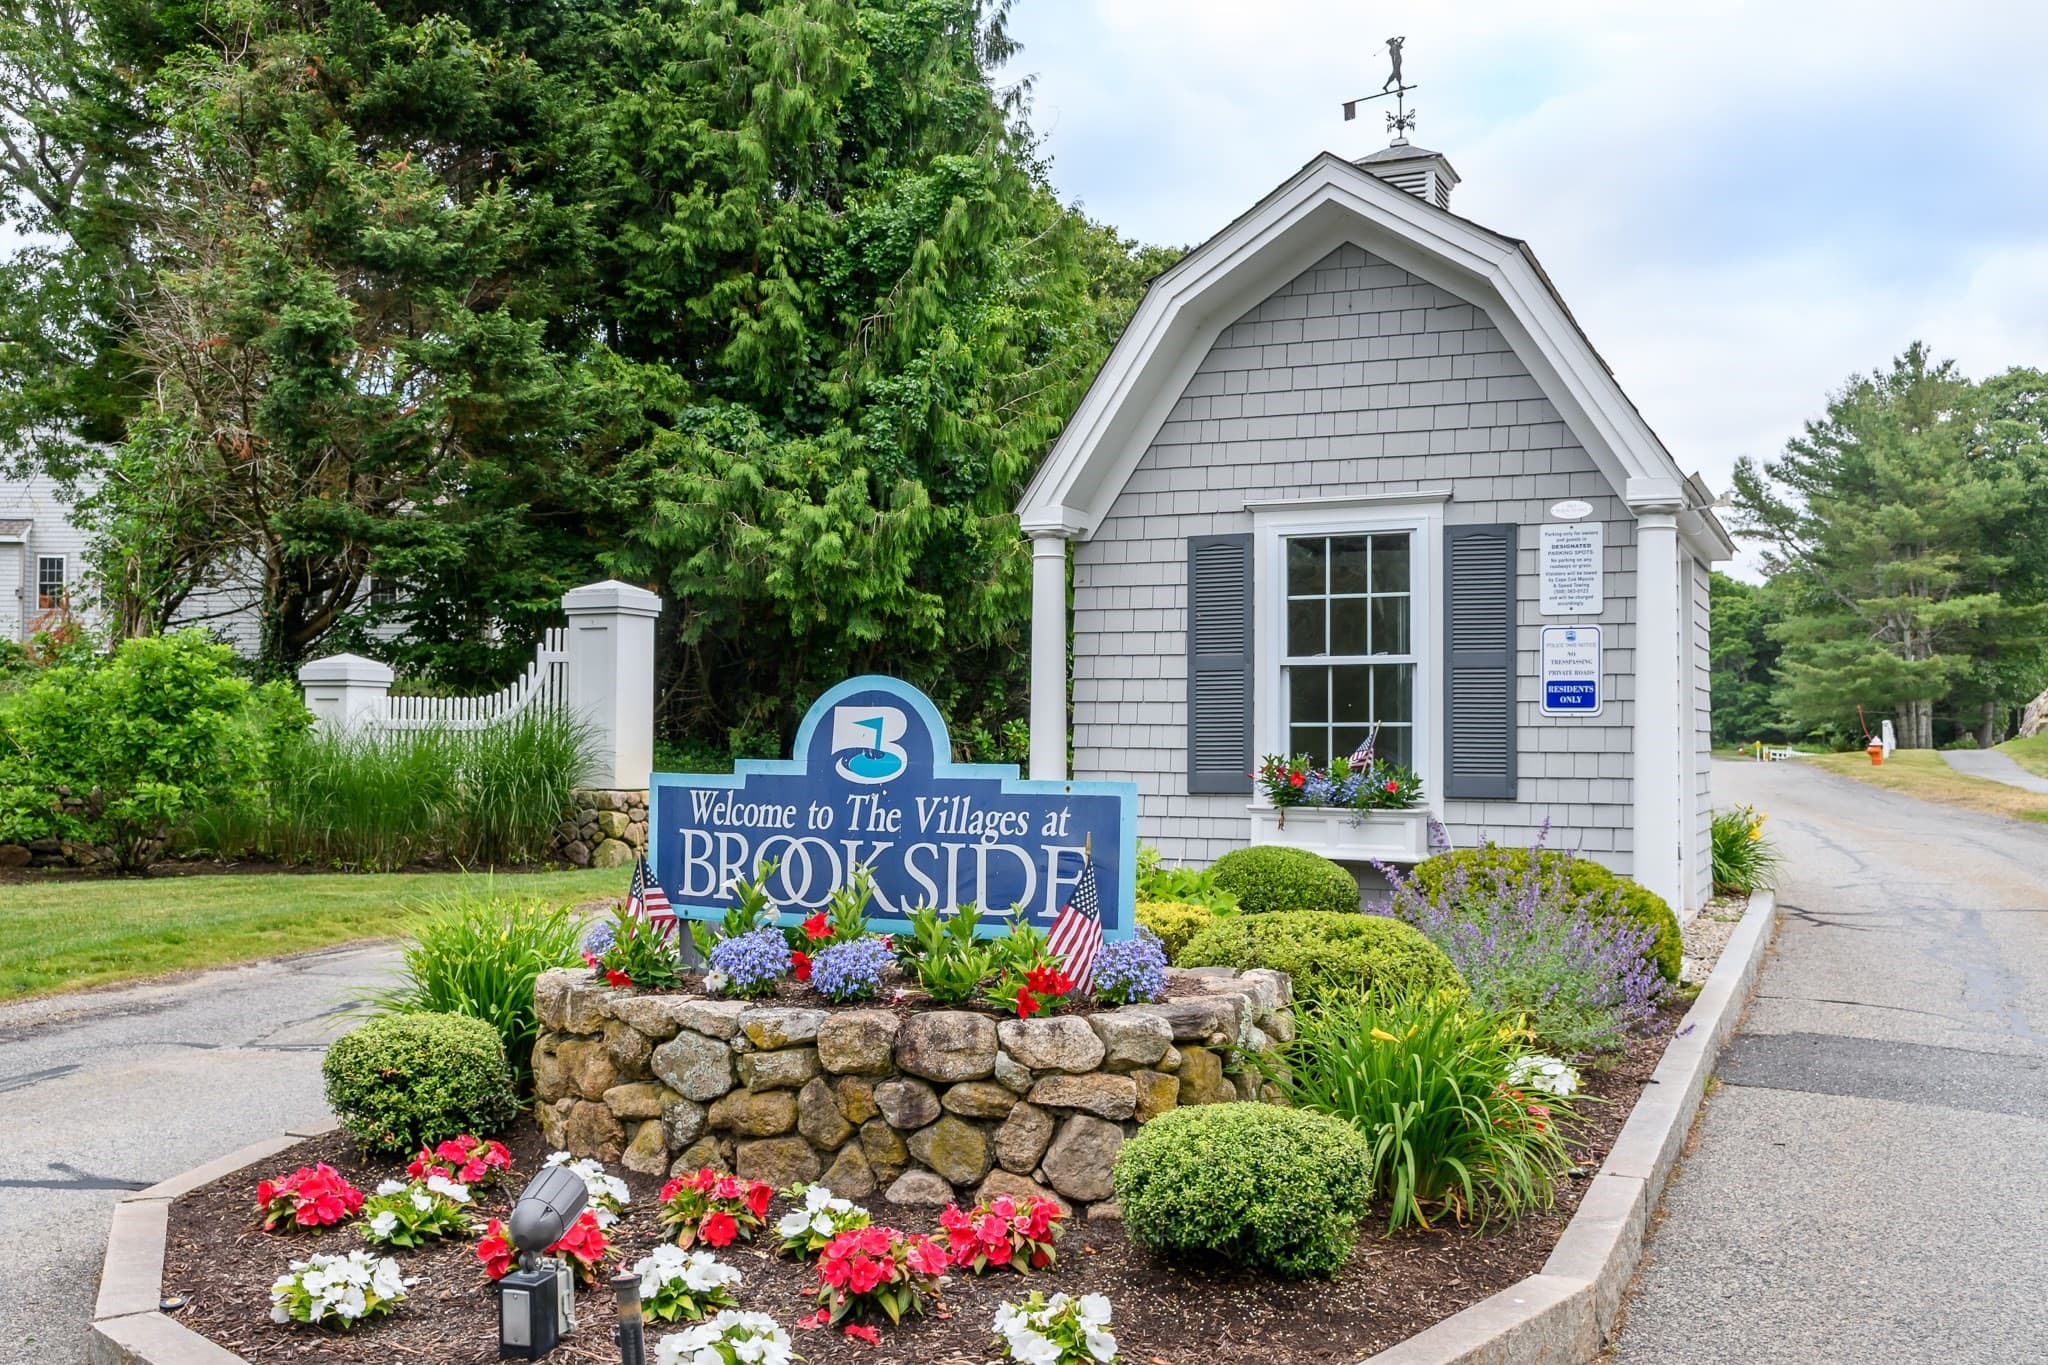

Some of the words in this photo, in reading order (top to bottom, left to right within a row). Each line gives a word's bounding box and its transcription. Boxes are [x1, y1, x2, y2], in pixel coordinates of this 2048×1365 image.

[1548, 684, 1594, 693] RESIDENTS
[1559, 695, 1583, 703] ONLY
[690, 789, 797, 829] Welcome
[808, 800, 834, 830] to
[846, 793, 902, 833] The
[915, 795, 1030, 846] Villages
[1041, 806, 1072, 838] at
